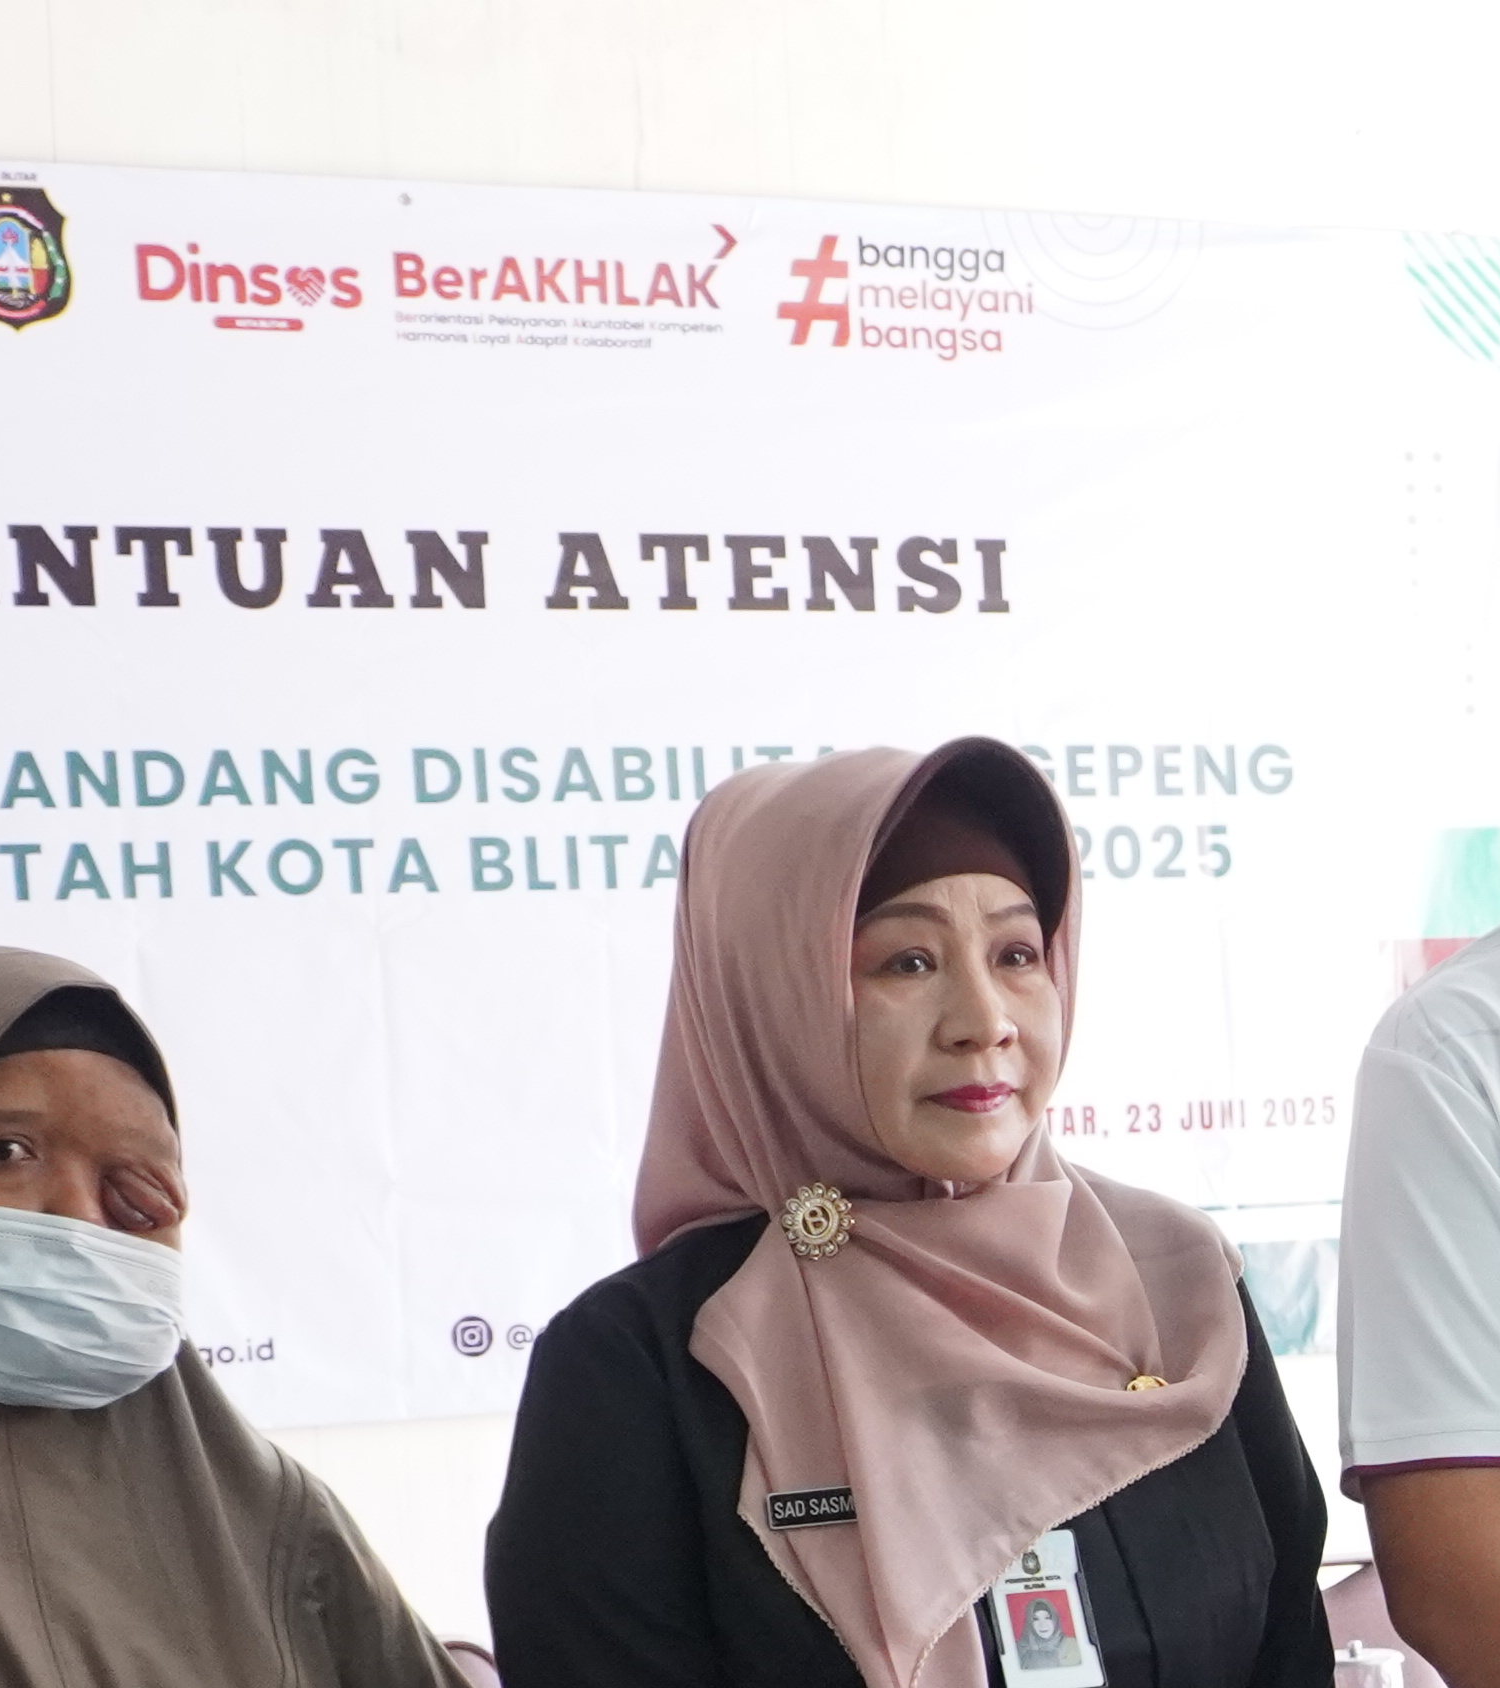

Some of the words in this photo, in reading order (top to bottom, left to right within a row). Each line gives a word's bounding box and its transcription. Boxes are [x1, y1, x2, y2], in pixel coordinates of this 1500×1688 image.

[393, 251, 721, 309] BerAKHLAK
[858, 236, 1005, 282] bangga
[395, 311, 484, 326] Berorientasi
[488, 313, 567, 330] Pelayanan
[572, 317, 645, 331] Akuntabel
[650, 319, 723, 334] Kompeten
[859, 280, 1034, 322] melayani
[396, 330, 468, 343] Harmonis
[573, 335, 652, 349] Kolaboratif
[860, 317, 1002, 361] bangsa
[545, 531, 1010, 614] ATENSI
[412, 745, 834, 804] DISABIL
[206, 837, 440, 898] KOTA
[468, 834, 678, 892] BLITA
[1075, 825, 1232, 880] 2025
[1046, 1104, 1109, 1138] TAR,
[1127, 1103, 1162, 1133] 23
[1181, 1099, 1246, 1131] JUNI
[1263, 1095, 1336, 1128] 2025
[773, 1500, 806, 1520] SAD
